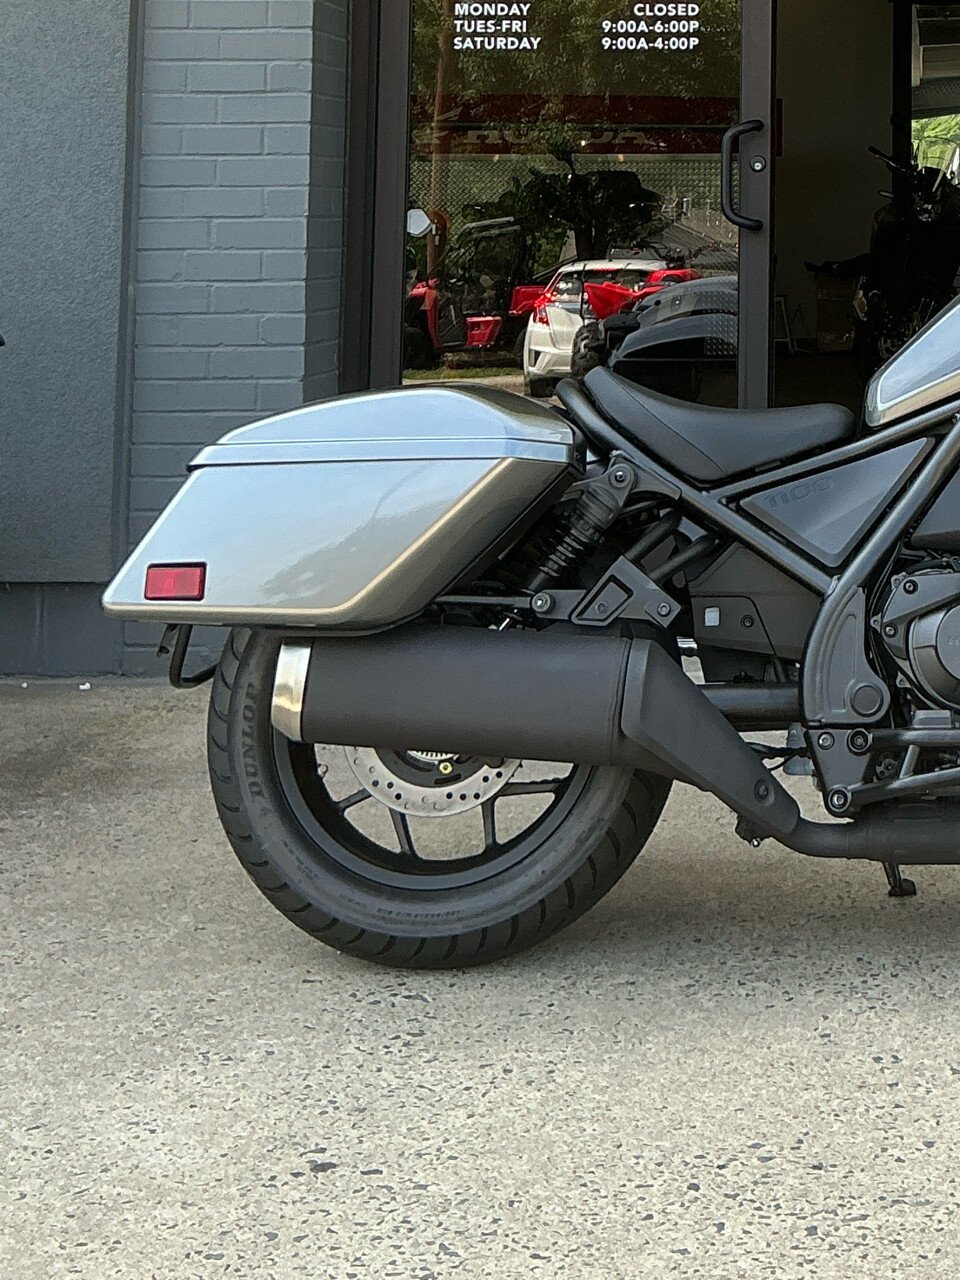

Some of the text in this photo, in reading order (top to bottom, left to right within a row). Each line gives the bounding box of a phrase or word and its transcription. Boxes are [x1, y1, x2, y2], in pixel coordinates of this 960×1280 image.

[454, 3, 699, 16] MONDAY CLOSED
[454, 20, 699, 33] TUES-FRI 9:00A-6:00P
[453, 37, 699, 50] SATURDAY 9:00A-4:00P
